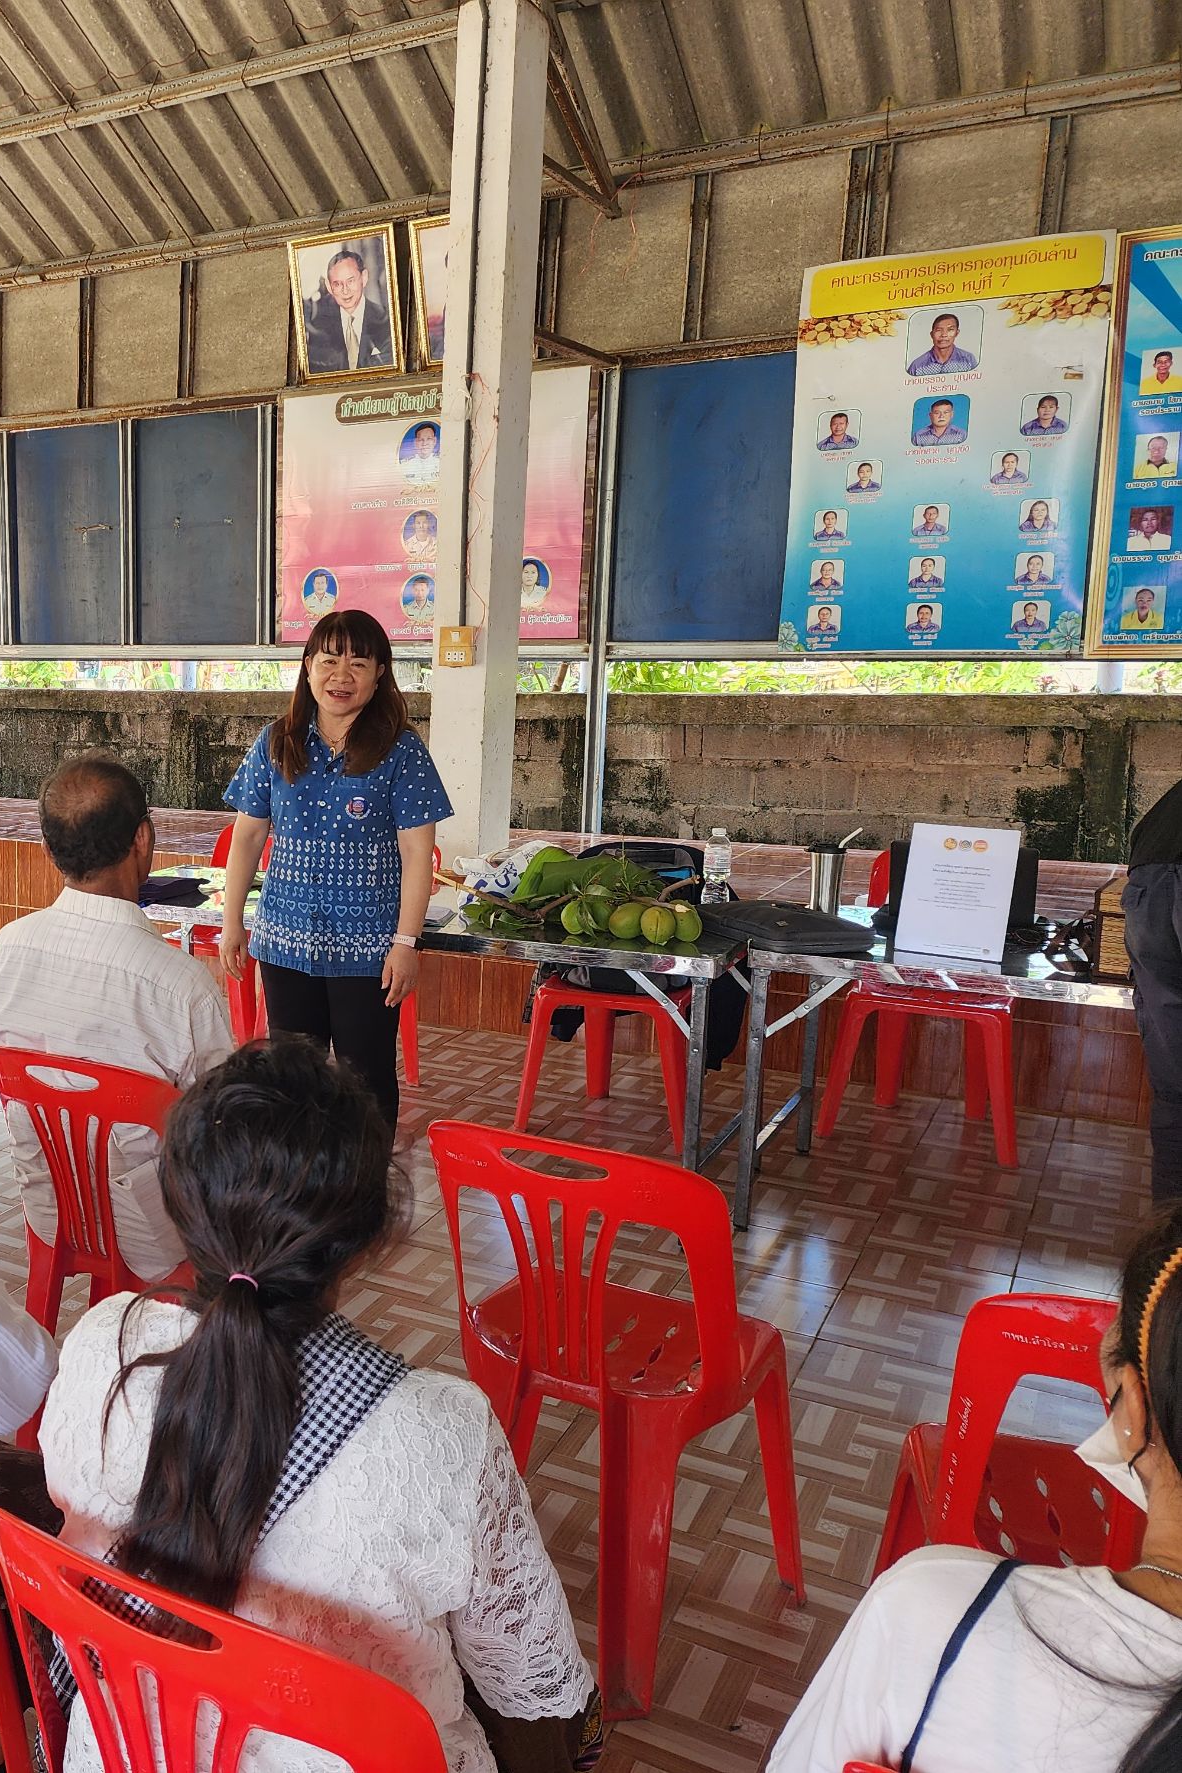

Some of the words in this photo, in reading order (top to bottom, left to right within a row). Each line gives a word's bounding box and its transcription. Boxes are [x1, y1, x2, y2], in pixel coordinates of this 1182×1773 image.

[831, 243, 1078, 288] คณะกรรมการบริหารกองทุนเงินล้าน
[1144, 248, 1182, 261] คณะกร
[887, 280, 954, 301] บ้านสำโรง
[961, 272, 993, 297] หมู่ที่
[999, 274, 1010, 288] 7
[341, 388, 442, 417] ทำเนียบผู้ใหญ่บ้า
